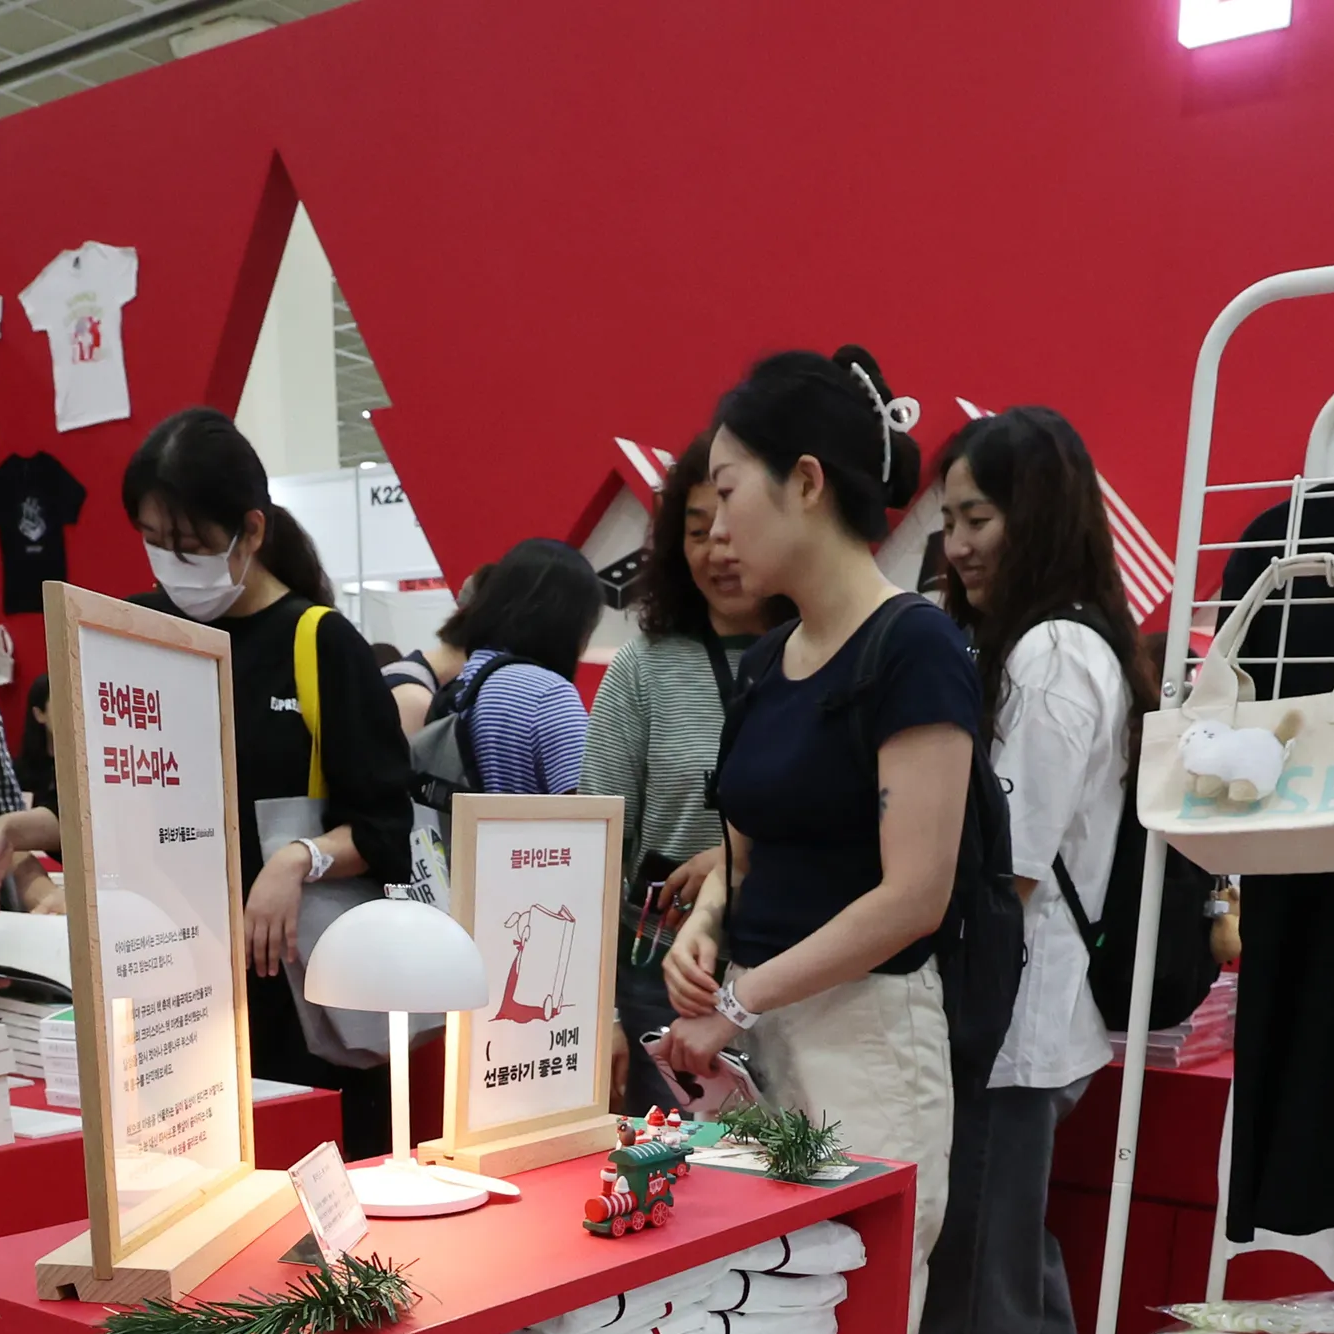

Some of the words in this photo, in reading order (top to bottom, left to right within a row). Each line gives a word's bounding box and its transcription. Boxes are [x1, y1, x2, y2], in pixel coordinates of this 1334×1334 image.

[98, 681, 162, 731] 한여름의
[103, 744, 180, 788] 크리스마스
[510, 847, 572, 869] 블라인드북
[483, 1060, 535, 1089] 선물하기
[538, 1056, 563, 1078] 좋은
[566, 1052, 578, 1072] 책
